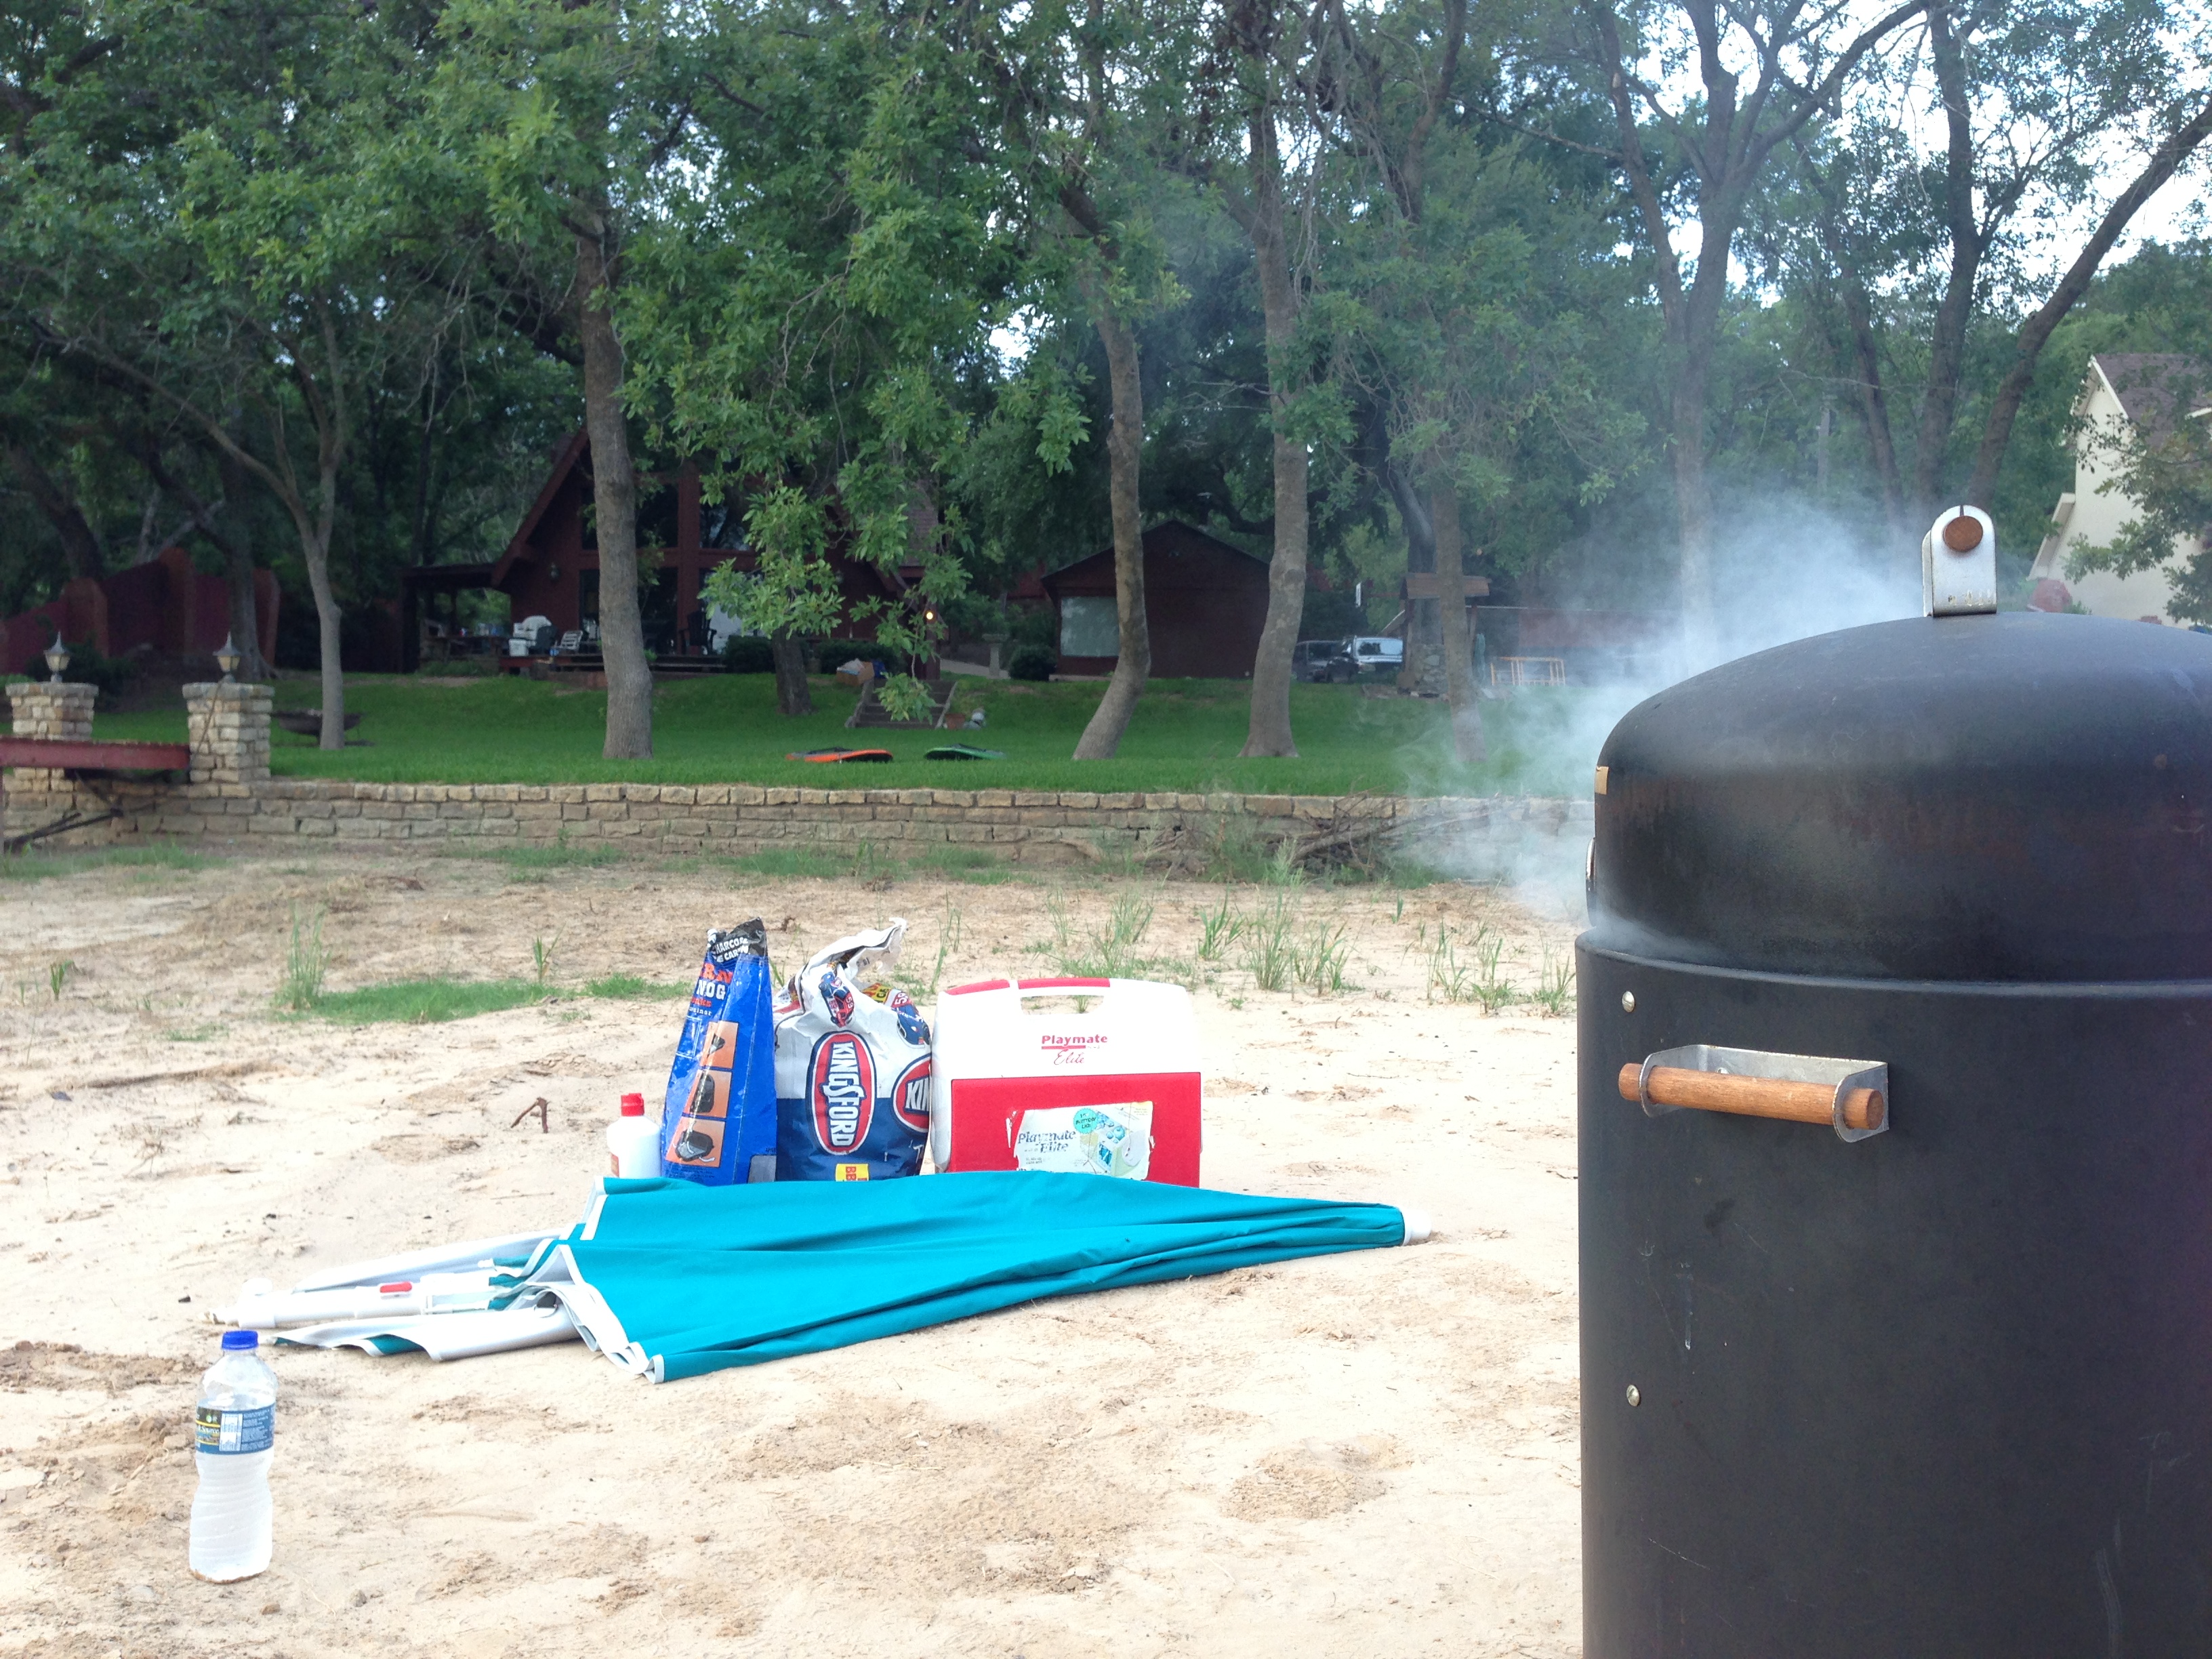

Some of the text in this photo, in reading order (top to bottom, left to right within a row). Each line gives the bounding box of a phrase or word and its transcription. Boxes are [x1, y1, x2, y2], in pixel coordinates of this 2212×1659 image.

[846, 996, 854, 1009] 59
[1042, 1034, 1108, 1046] Playmate
[1053, 1048, 1085, 1065] Elite
[823, 1042, 865, 1146] KINGSFORD
[1017, 1129, 1078, 1145] Playmate
[1039, 1141, 1069, 1153] Elite
